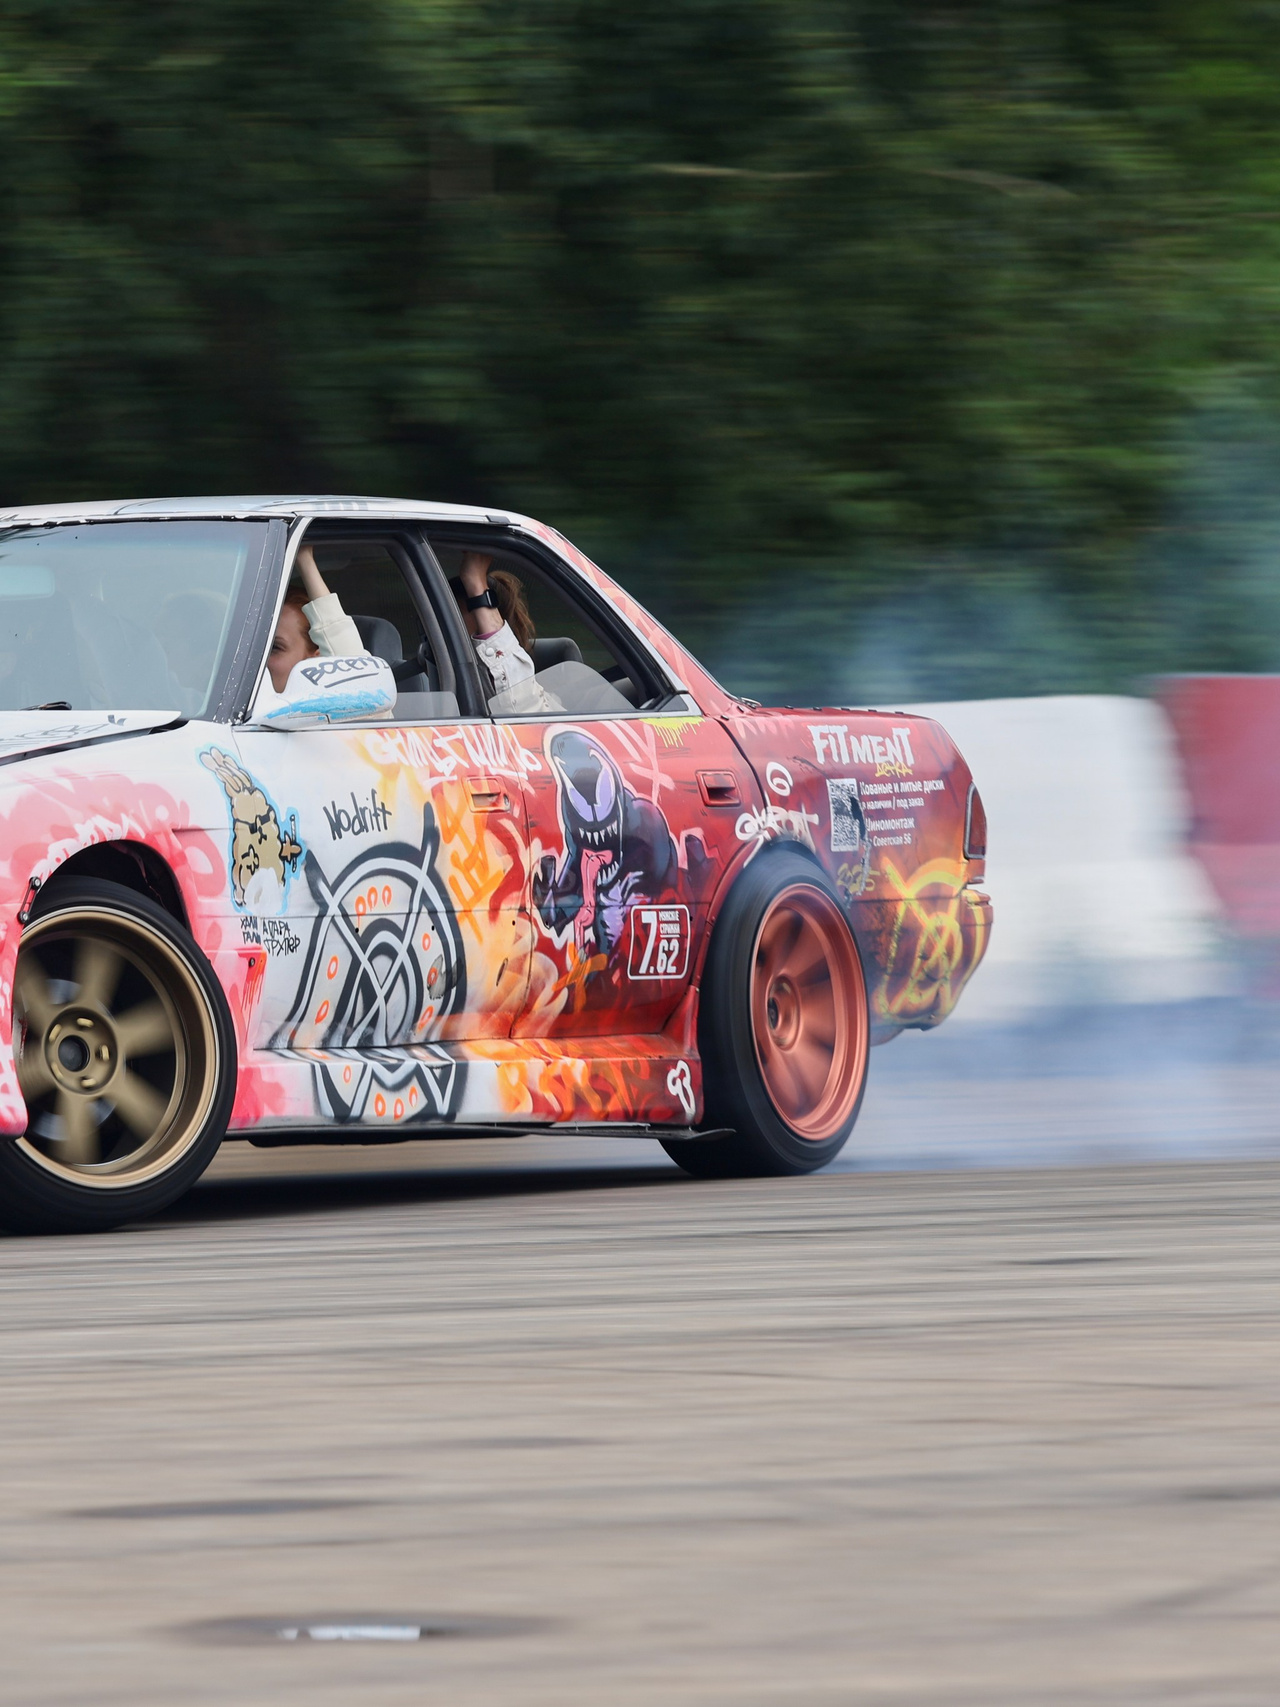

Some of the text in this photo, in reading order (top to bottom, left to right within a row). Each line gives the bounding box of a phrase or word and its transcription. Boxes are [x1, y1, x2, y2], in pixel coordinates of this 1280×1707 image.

[859, 779, 945, 796] Кованые и литые диски
[896, 800, 909, 810] под
[909, 797, 925, 807] заказ
[873, 835, 903, 847] Советская
